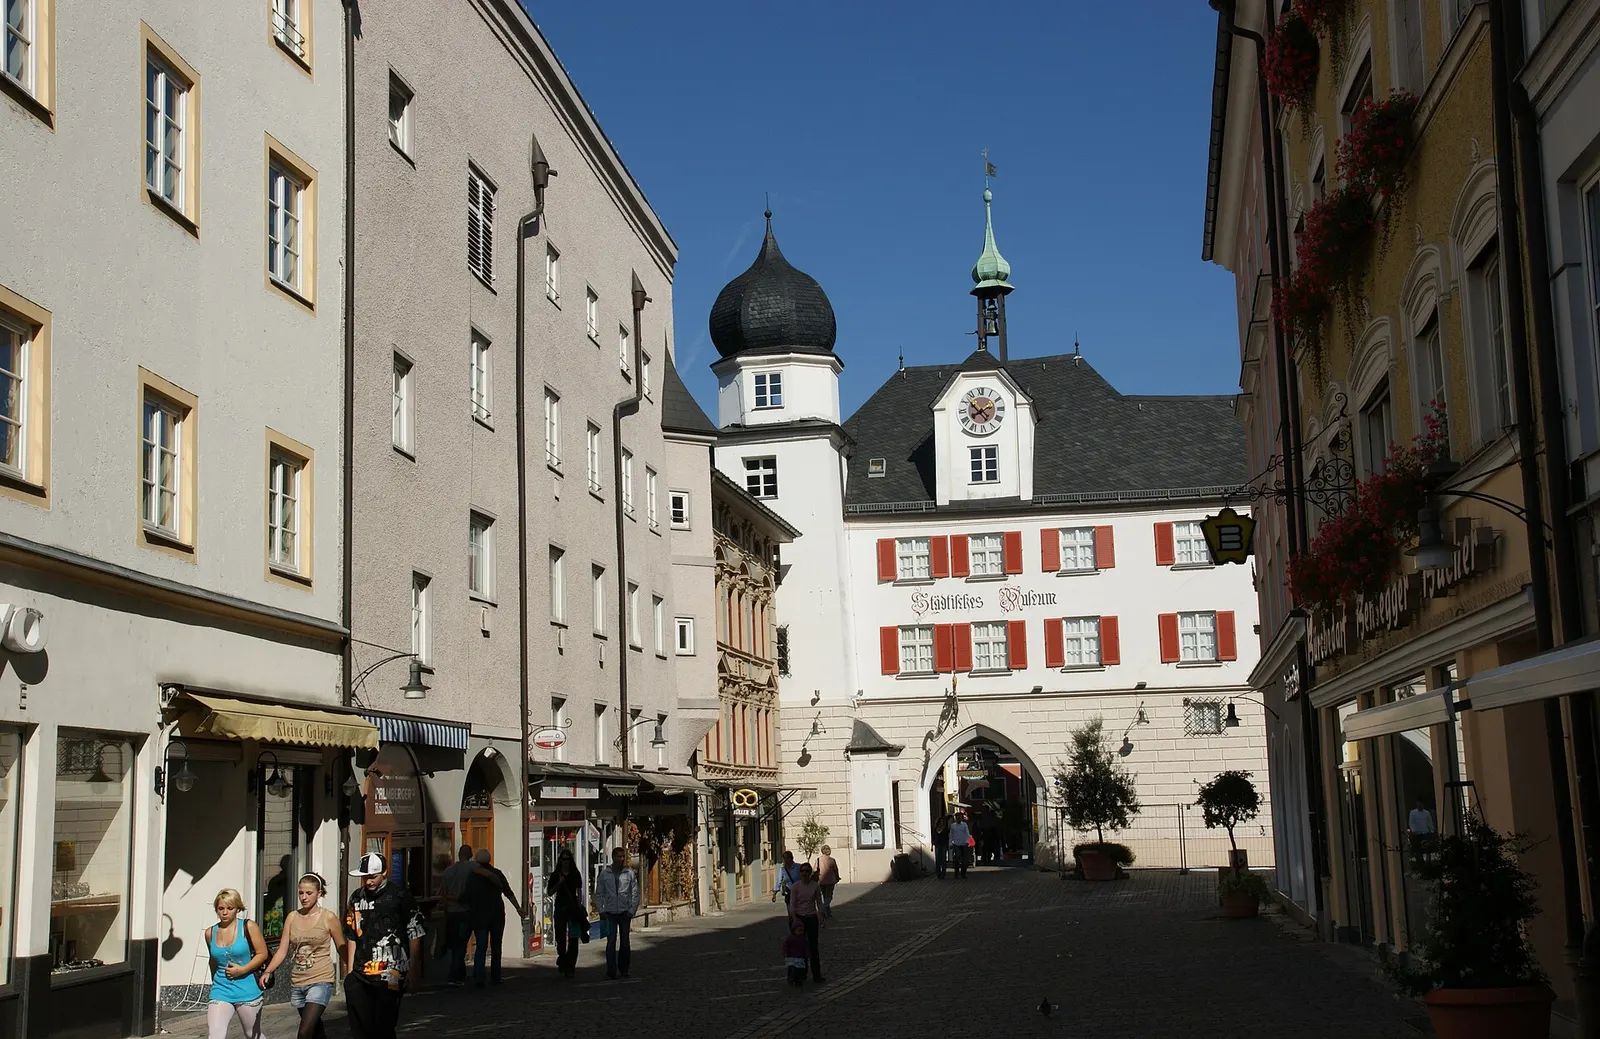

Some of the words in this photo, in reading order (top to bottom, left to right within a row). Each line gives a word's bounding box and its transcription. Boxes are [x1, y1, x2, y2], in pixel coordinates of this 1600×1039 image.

[911, 589, 984, 617] Städtisches
[999, 584, 1057, 613] Museum
[276, 721, 304, 738] Kleine
[306, 723, 337, 741] Galerie
